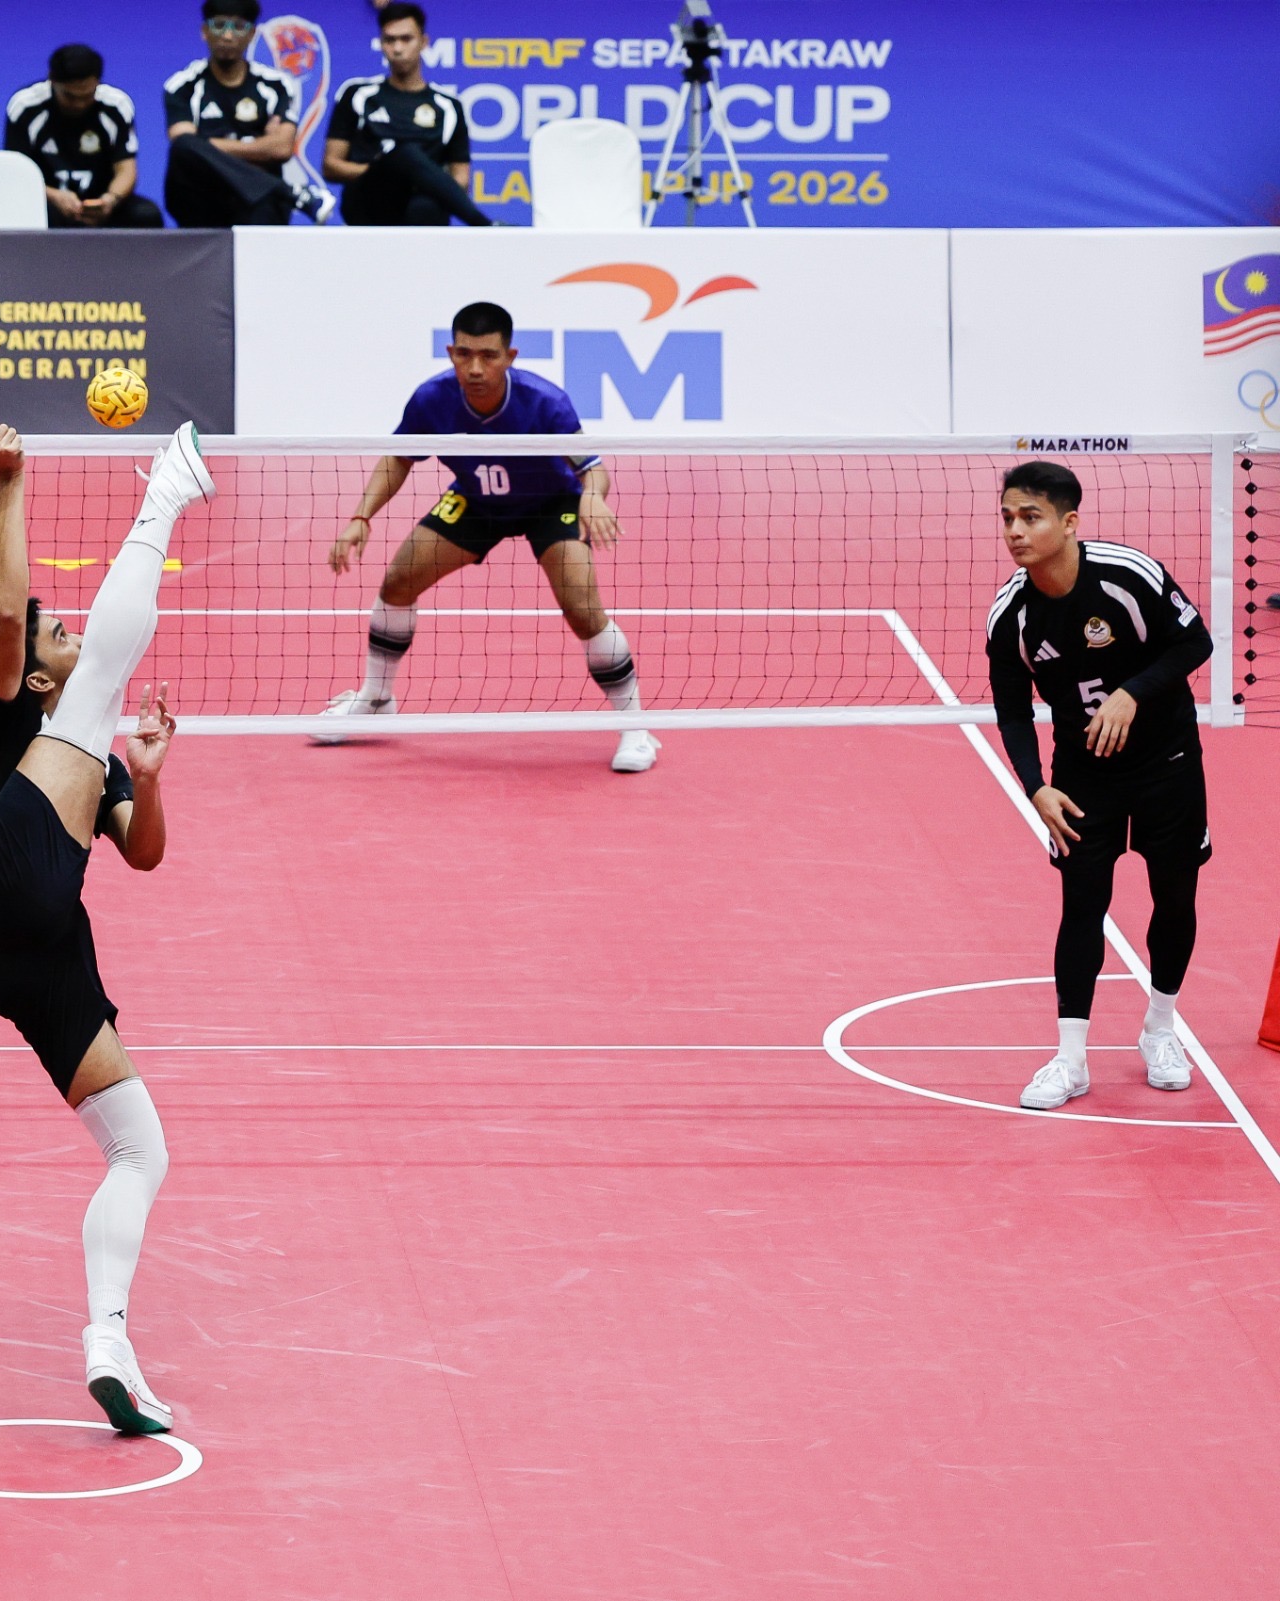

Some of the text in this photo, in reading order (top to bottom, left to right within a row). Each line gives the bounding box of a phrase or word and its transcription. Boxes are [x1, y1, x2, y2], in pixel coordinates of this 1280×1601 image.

[462, 38, 586, 67] ISTAF
[592, 39, 892, 68] SEPATAKRAW
[710, 83, 891, 142] CUP
[768, 171, 889, 205] 2026
[1030, 438, 1128, 452] MARATHON
[474, 464, 511, 496] 10
[1078, 677, 1111, 717] 5
